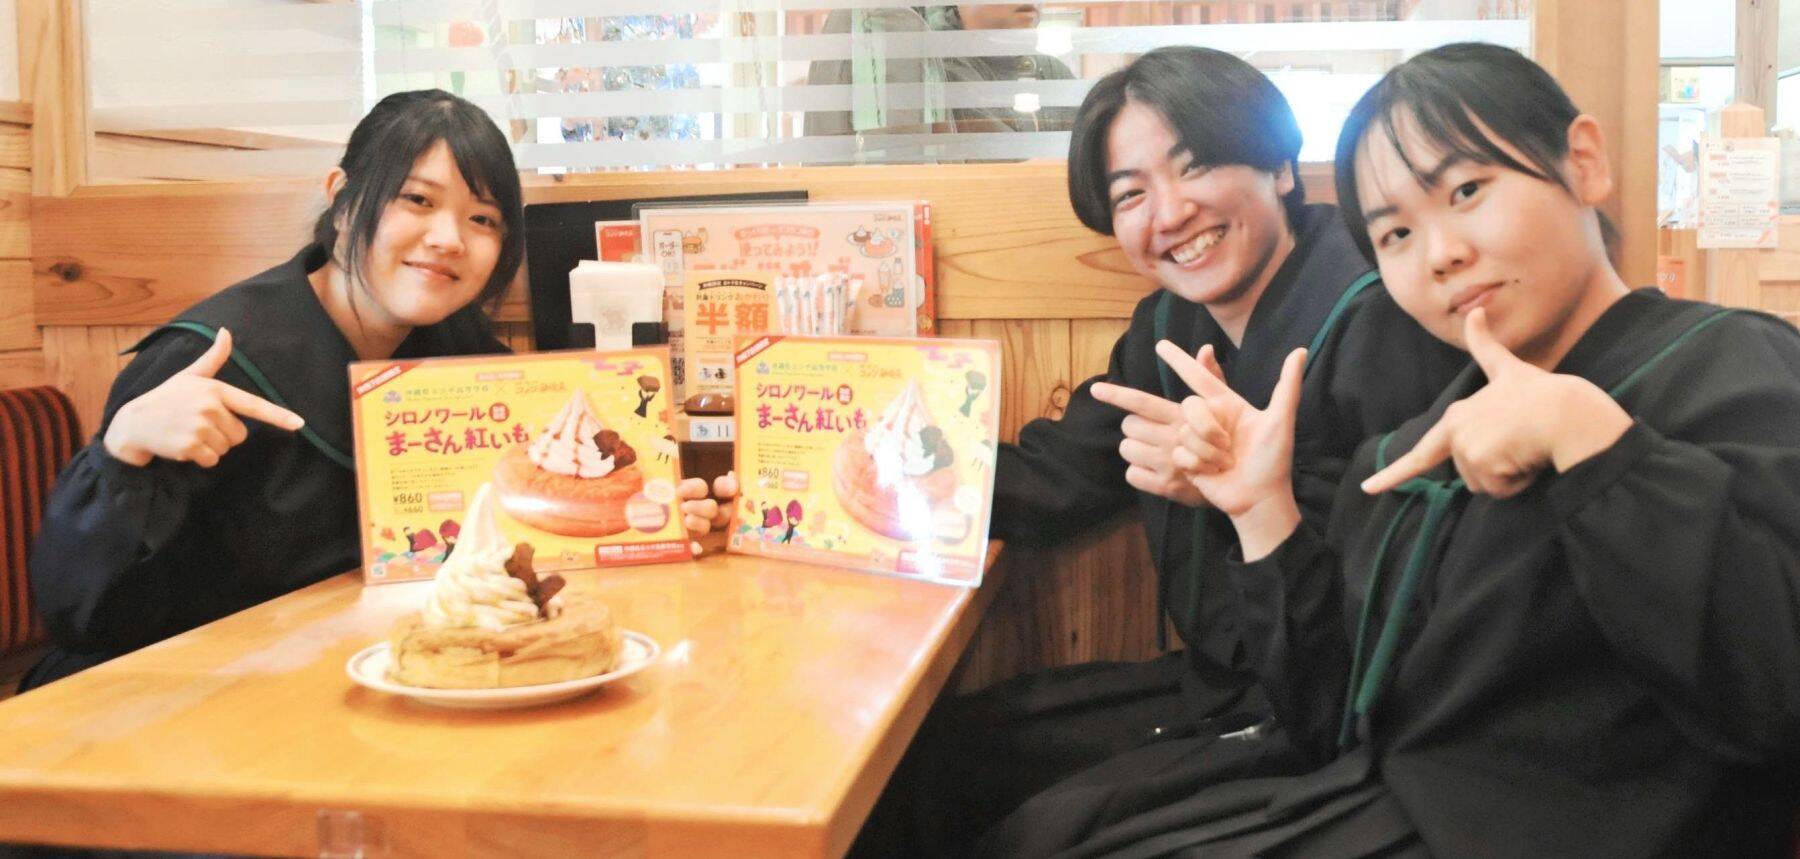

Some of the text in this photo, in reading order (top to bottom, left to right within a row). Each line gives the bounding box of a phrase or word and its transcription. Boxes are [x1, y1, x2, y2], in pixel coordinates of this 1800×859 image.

[696, 303, 769, 334] 半額
[756, 382, 834, 400] シロノワール
[384, 407, 487, 426] シロノワール
[756, 403, 867, 433] まーさん紅いも
[386, 423, 529, 456] まーさん紅いも
[393, 492, 423, 504] ¥860
